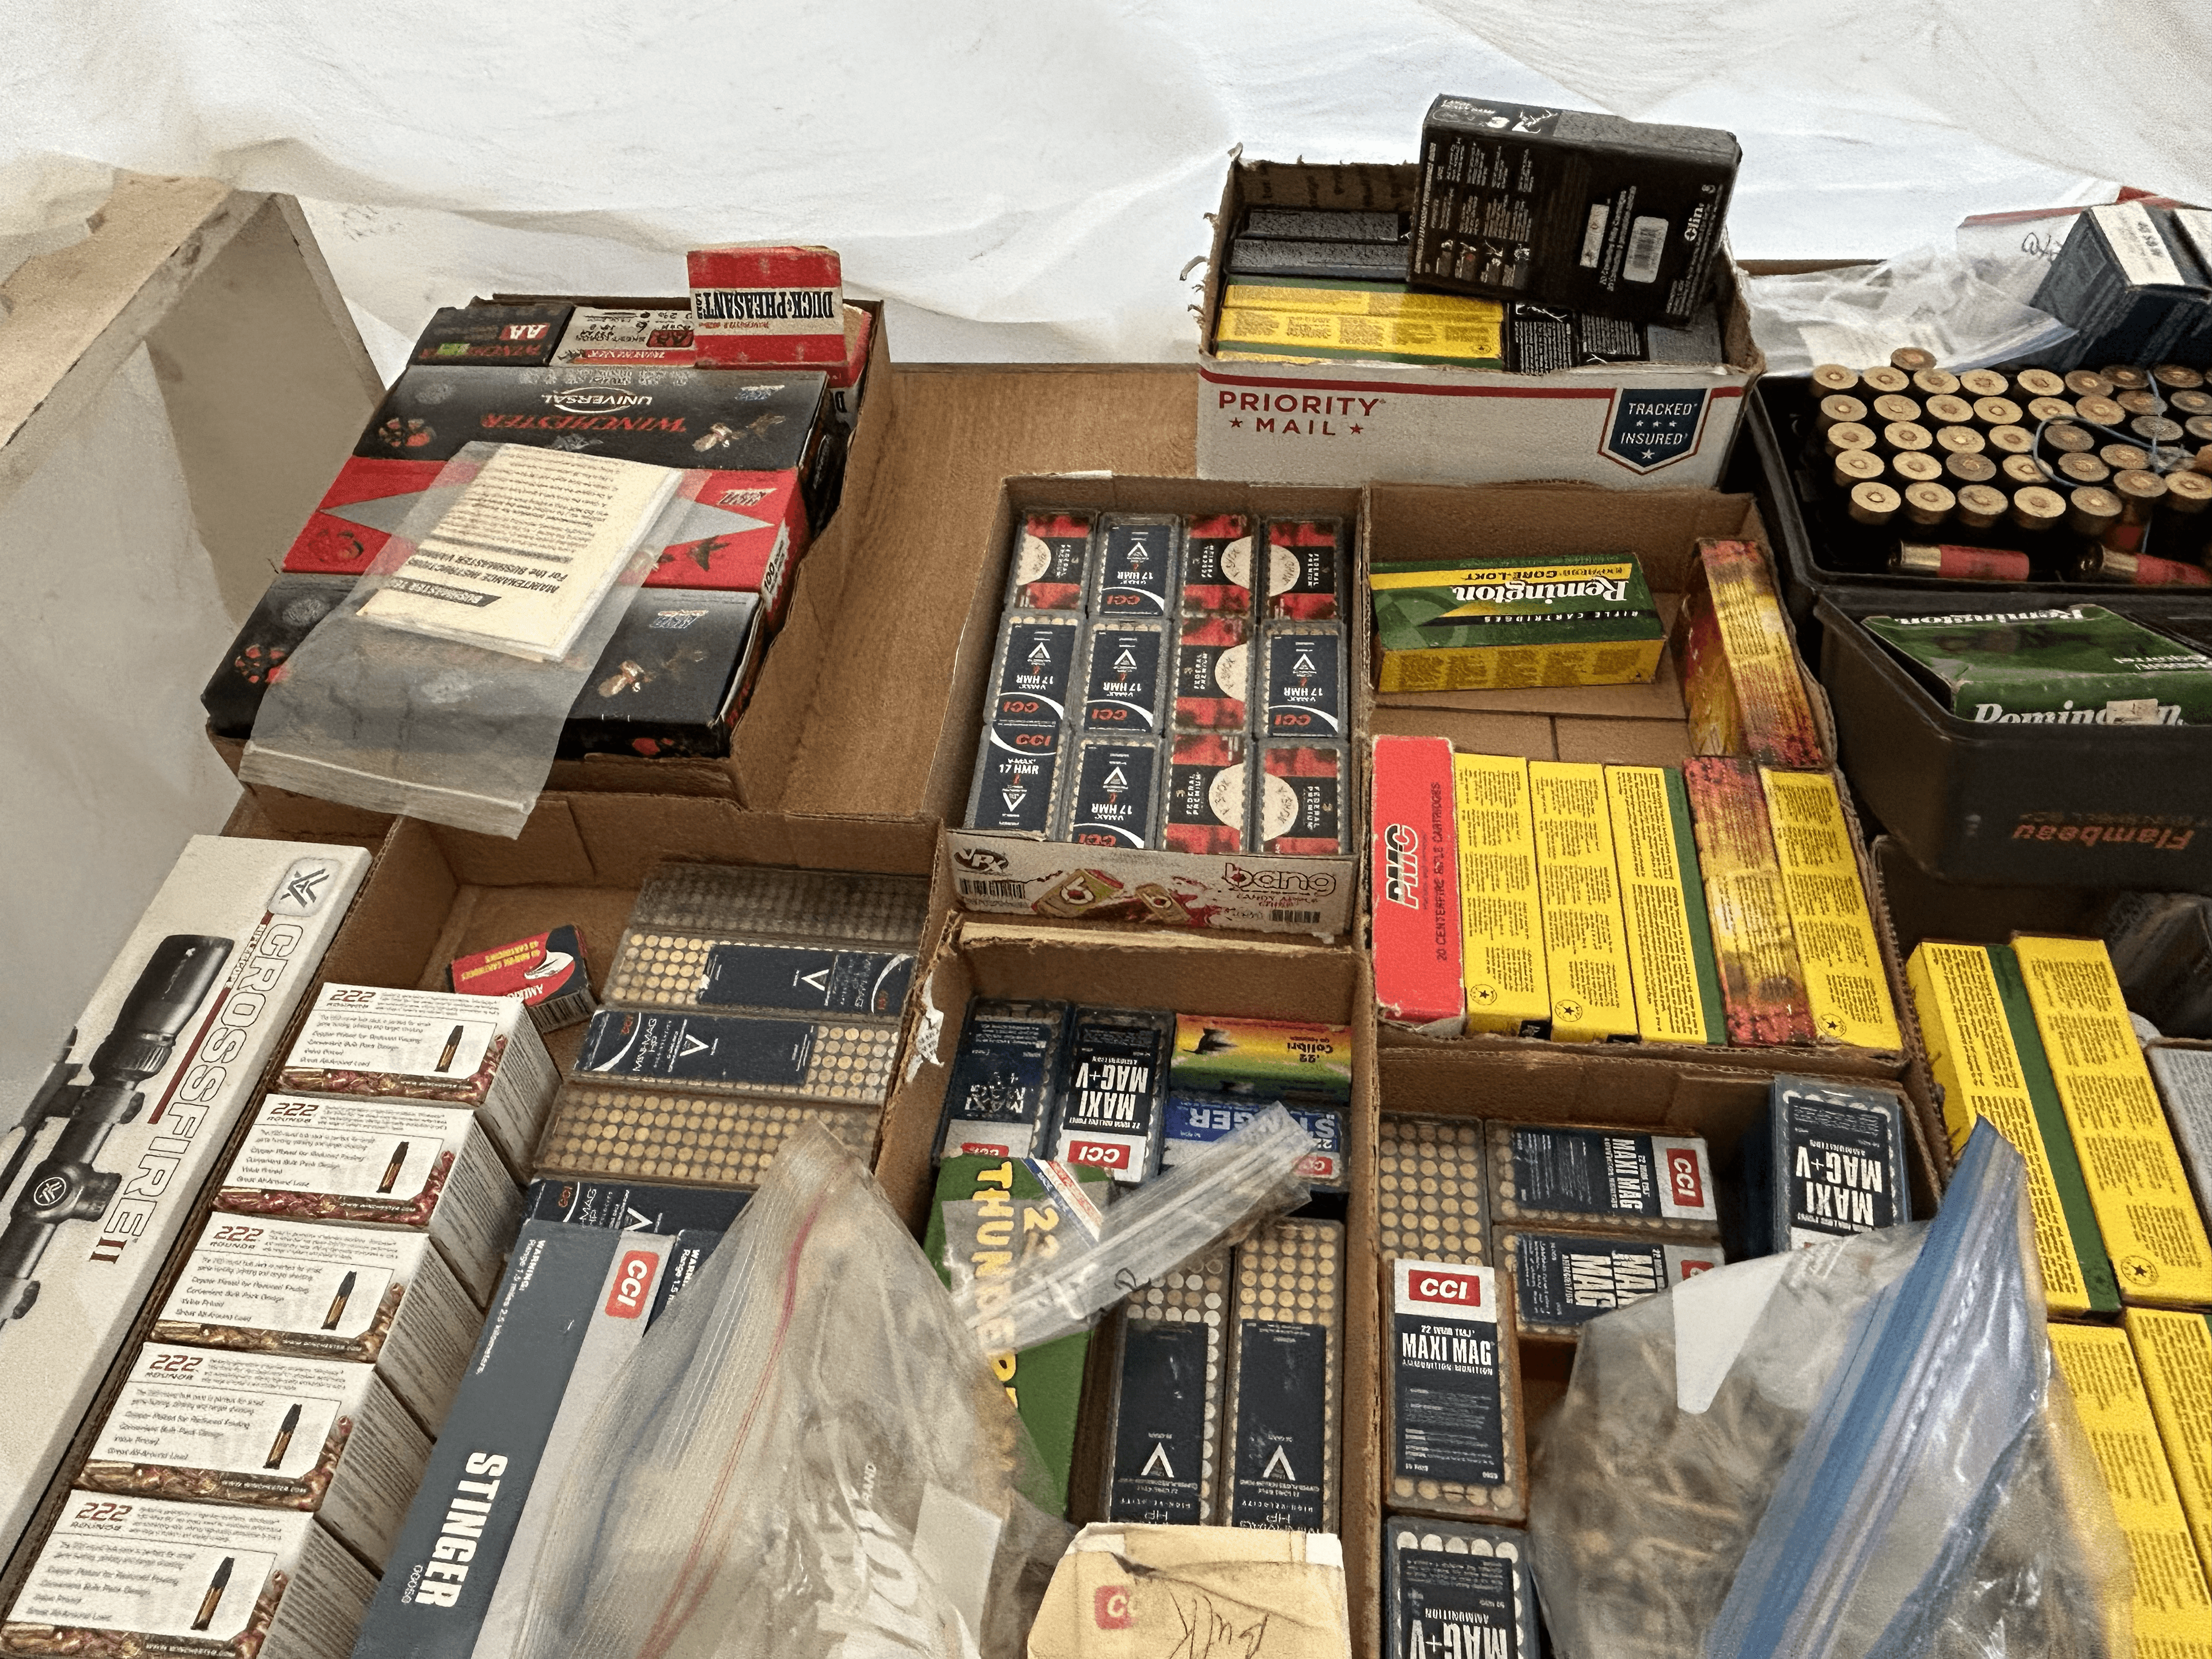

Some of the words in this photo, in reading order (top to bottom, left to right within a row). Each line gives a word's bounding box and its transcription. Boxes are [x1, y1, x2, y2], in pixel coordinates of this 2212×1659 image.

[702, 291, 787, 319] PHEASANT
[789, 291, 834, 319] DUCK
[509, 324, 547, 340] AA
[544, 393, 653, 406] UNIVERSAL
[1218, 391, 1379, 416] PRIORITY
[1628, 400, 1694, 417] TRACKED
[481, 414, 687, 434] WINCHESTER
[1256, 417, 1338, 437] MAIL
[1620, 431, 1685, 446] INSURED
[1142, 571, 1154, 580] 17
[1452, 575, 1629, 604] Remington
[1107, 595, 1141, 605] CCI
[1483, 612, 1584, 623] CARTRIDGES
[1016, 674, 1039, 685] HMR
[1043, 675, 1054, 684] 17
[1102, 681, 1125, 691] HMR
[1128, 683, 1142, 691] 17
[1283, 687, 1309, 696] HMR
[1310, 687, 1324, 696] 17
[1002, 700, 1040, 714] CCI
[1091, 708, 1128, 721] CCI
[1274, 714, 1312, 726] CCI
[1016, 733, 1052, 747] CCI
[999, 764, 1012, 774] 17
[1013, 764, 1040, 775] HMR
[1091, 803, 1118, 815] HMR
[1120, 804, 1133, 815] 17
[1078, 834, 1116, 847] CCI
[2012, 824, 2195, 850] Flambeau
[1384, 823, 1419, 910] PMC
[1225, 862, 1336, 897] bang
[1435, 948, 1447, 961] 20
[329, 990, 376, 1002] 222
[1286, 1041, 1334, 1054] Colibri
[103, 923, 304, 1238] CROSSFIRE
[1075, 1062, 1149, 1094] MAG+V
[270, 1102, 319, 1117] 222
[1078, 1090, 1137, 1121] MAXI
[1078, 1146, 1120, 1163] CCI
[1612, 1138, 1639, 1175] MAXI
[1673, 1157, 1696, 1198] CCI
[1795, 1145, 1883, 1194] MAG+V
[1615, 1176, 1643, 1210] MAG
[1805, 1181, 1874, 1227] MAXI
[214, 1225, 264, 1242] 222
[89, 1237, 127, 1264] II
[616, 1259, 647, 1307] CCI
[1419, 1277, 1468, 1300] CCI
[1570, 1253, 1617, 1308] MAG
[1421, 1324, 1431, 1334] 22
[1402, 1332, 1448, 1362] MAXI
[1452, 1338, 1493, 1367] MAG
[149, 1354, 203, 1372] 222
[74, 1502, 133, 1522] 222
[1143, 1510, 1168, 1520] HP
[1266, 1513, 1291, 1524] HP
[414, 1452, 509, 1608] STINGER
[1410, 1619, 1508, 1659] MAG+V
